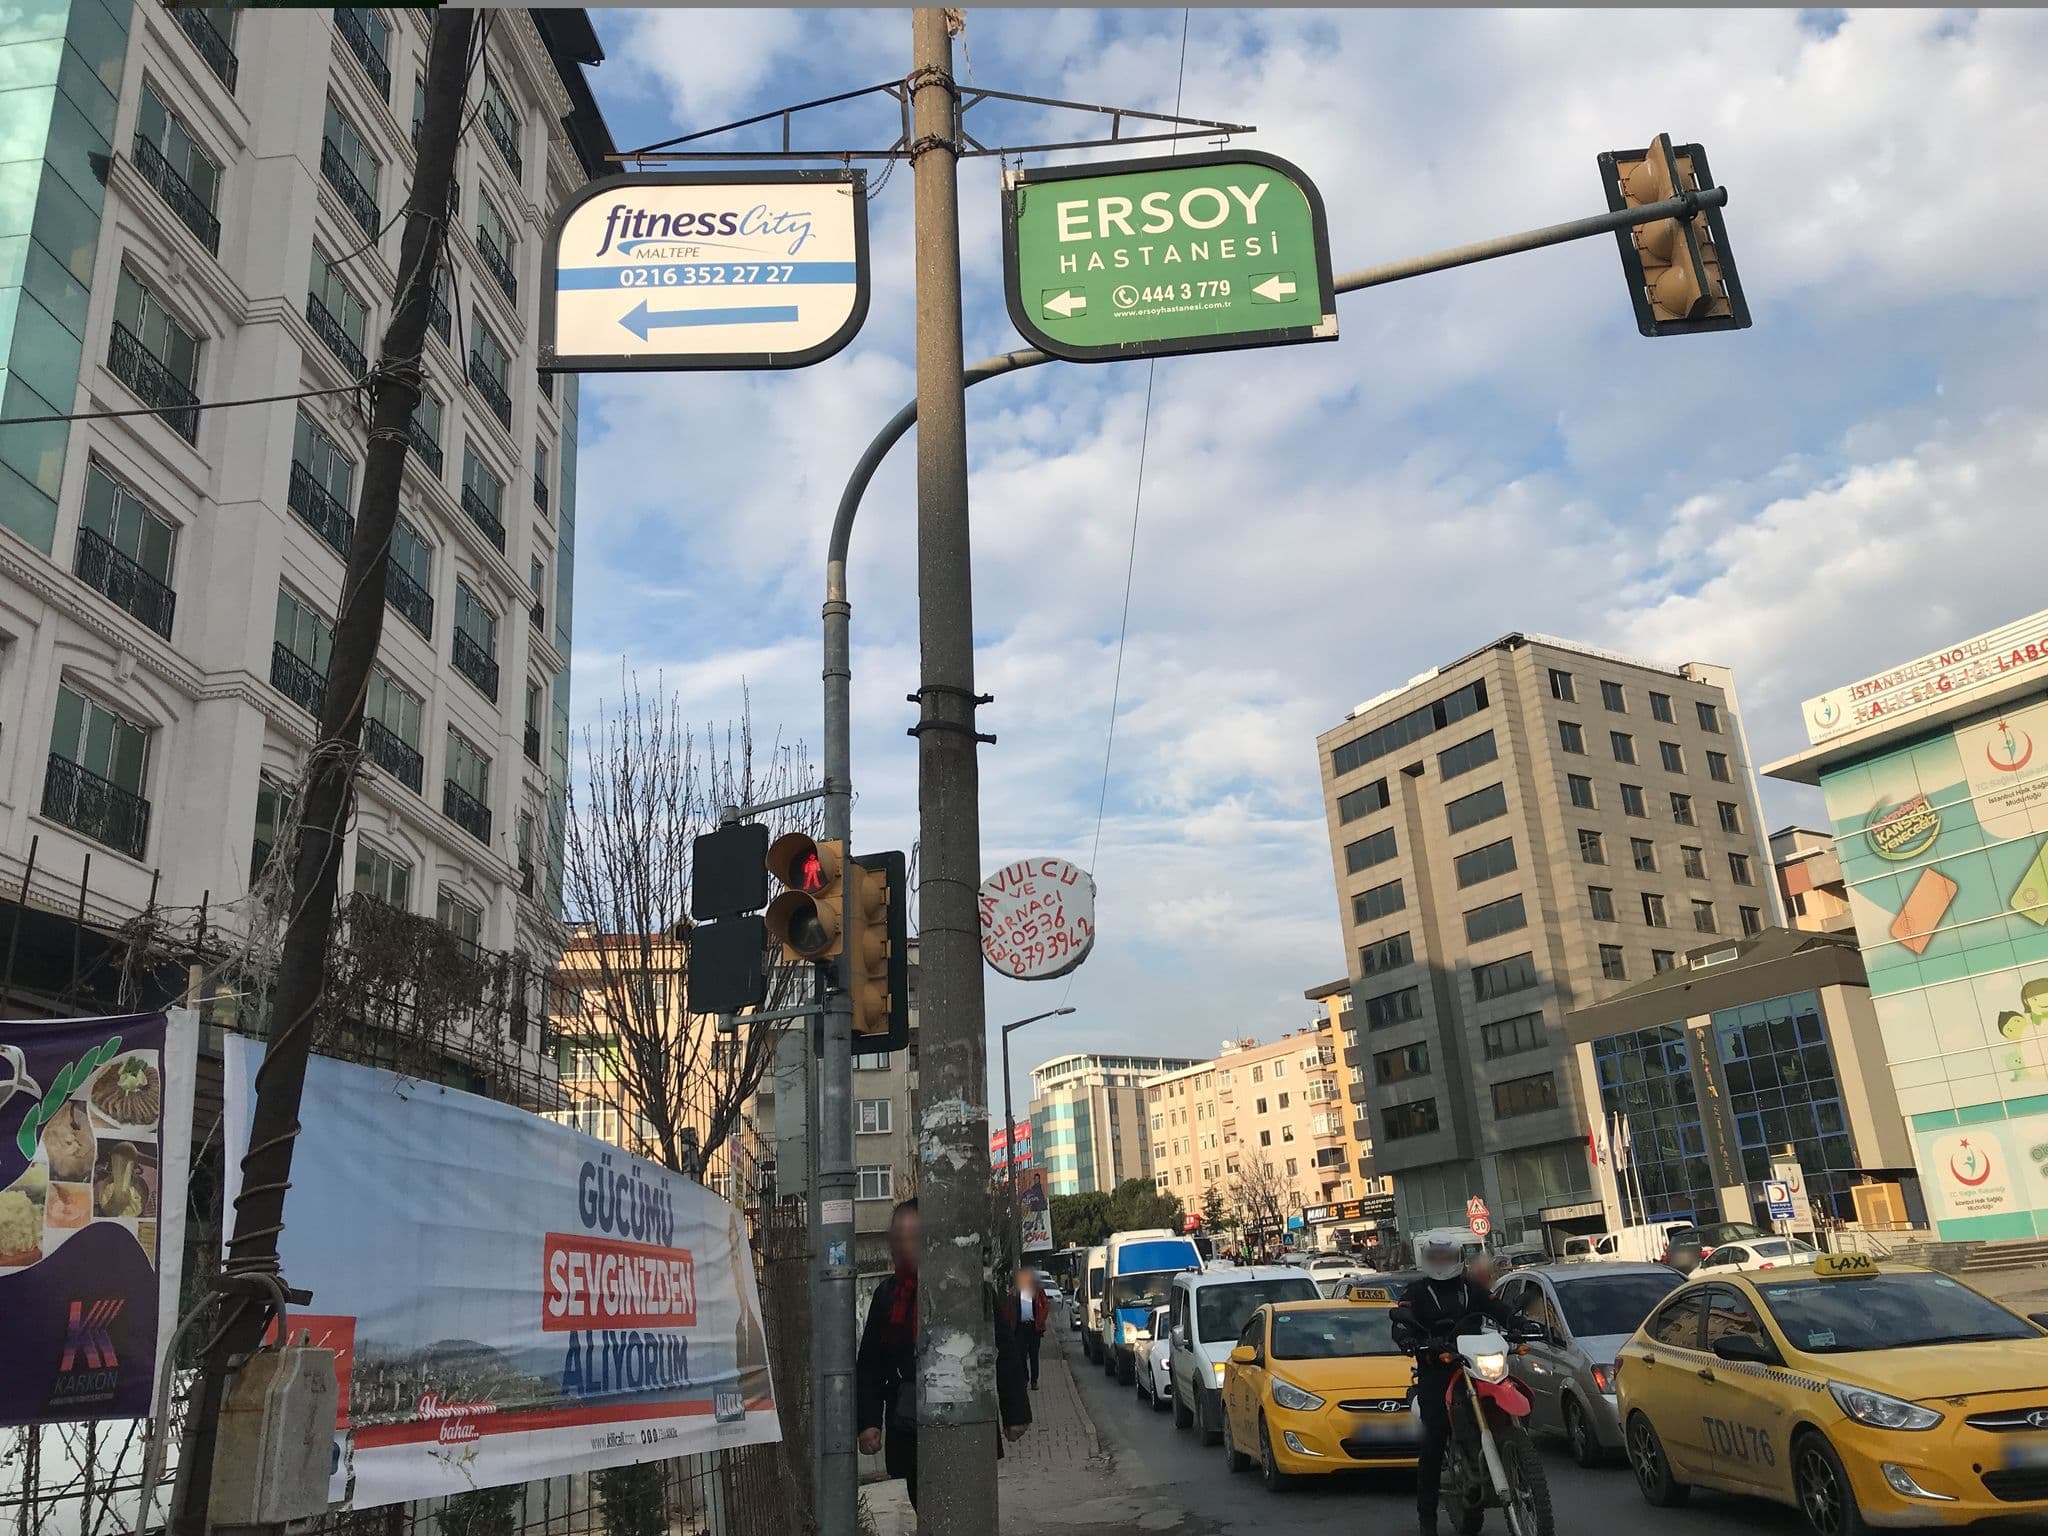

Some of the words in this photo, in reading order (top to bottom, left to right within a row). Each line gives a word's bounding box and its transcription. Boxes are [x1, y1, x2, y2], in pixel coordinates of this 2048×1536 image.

[1057, 183, 1270, 242] ERSOY
[636, 246, 701, 260] MALTEPE
[1060, 231, 1278, 274] HASTANESİ
[620, 269, 677, 286] 0216
[683, 267, 726, 284] 352
[732, 266, 761, 283] 27
[766, 265, 794, 283] 27
[1141, 285, 1175, 303] 444
[1180, 283, 1192, 300] 3
[1197, 280, 1231, 298] 779
[1113, 301, 1232, 318] www.ersoyhastanesi.com.tr
[1009, 882, 1036, 898] VE
[1011, 905, 1066, 946] 0536
[578, 1153, 674, 1247] GÜCÜMÜ
[1474, 1221, 1486, 1231] 30
[1824, 1256, 1870, 1270] TAXI
[549, 1249, 694, 1317] SEVGİNİZDEN
